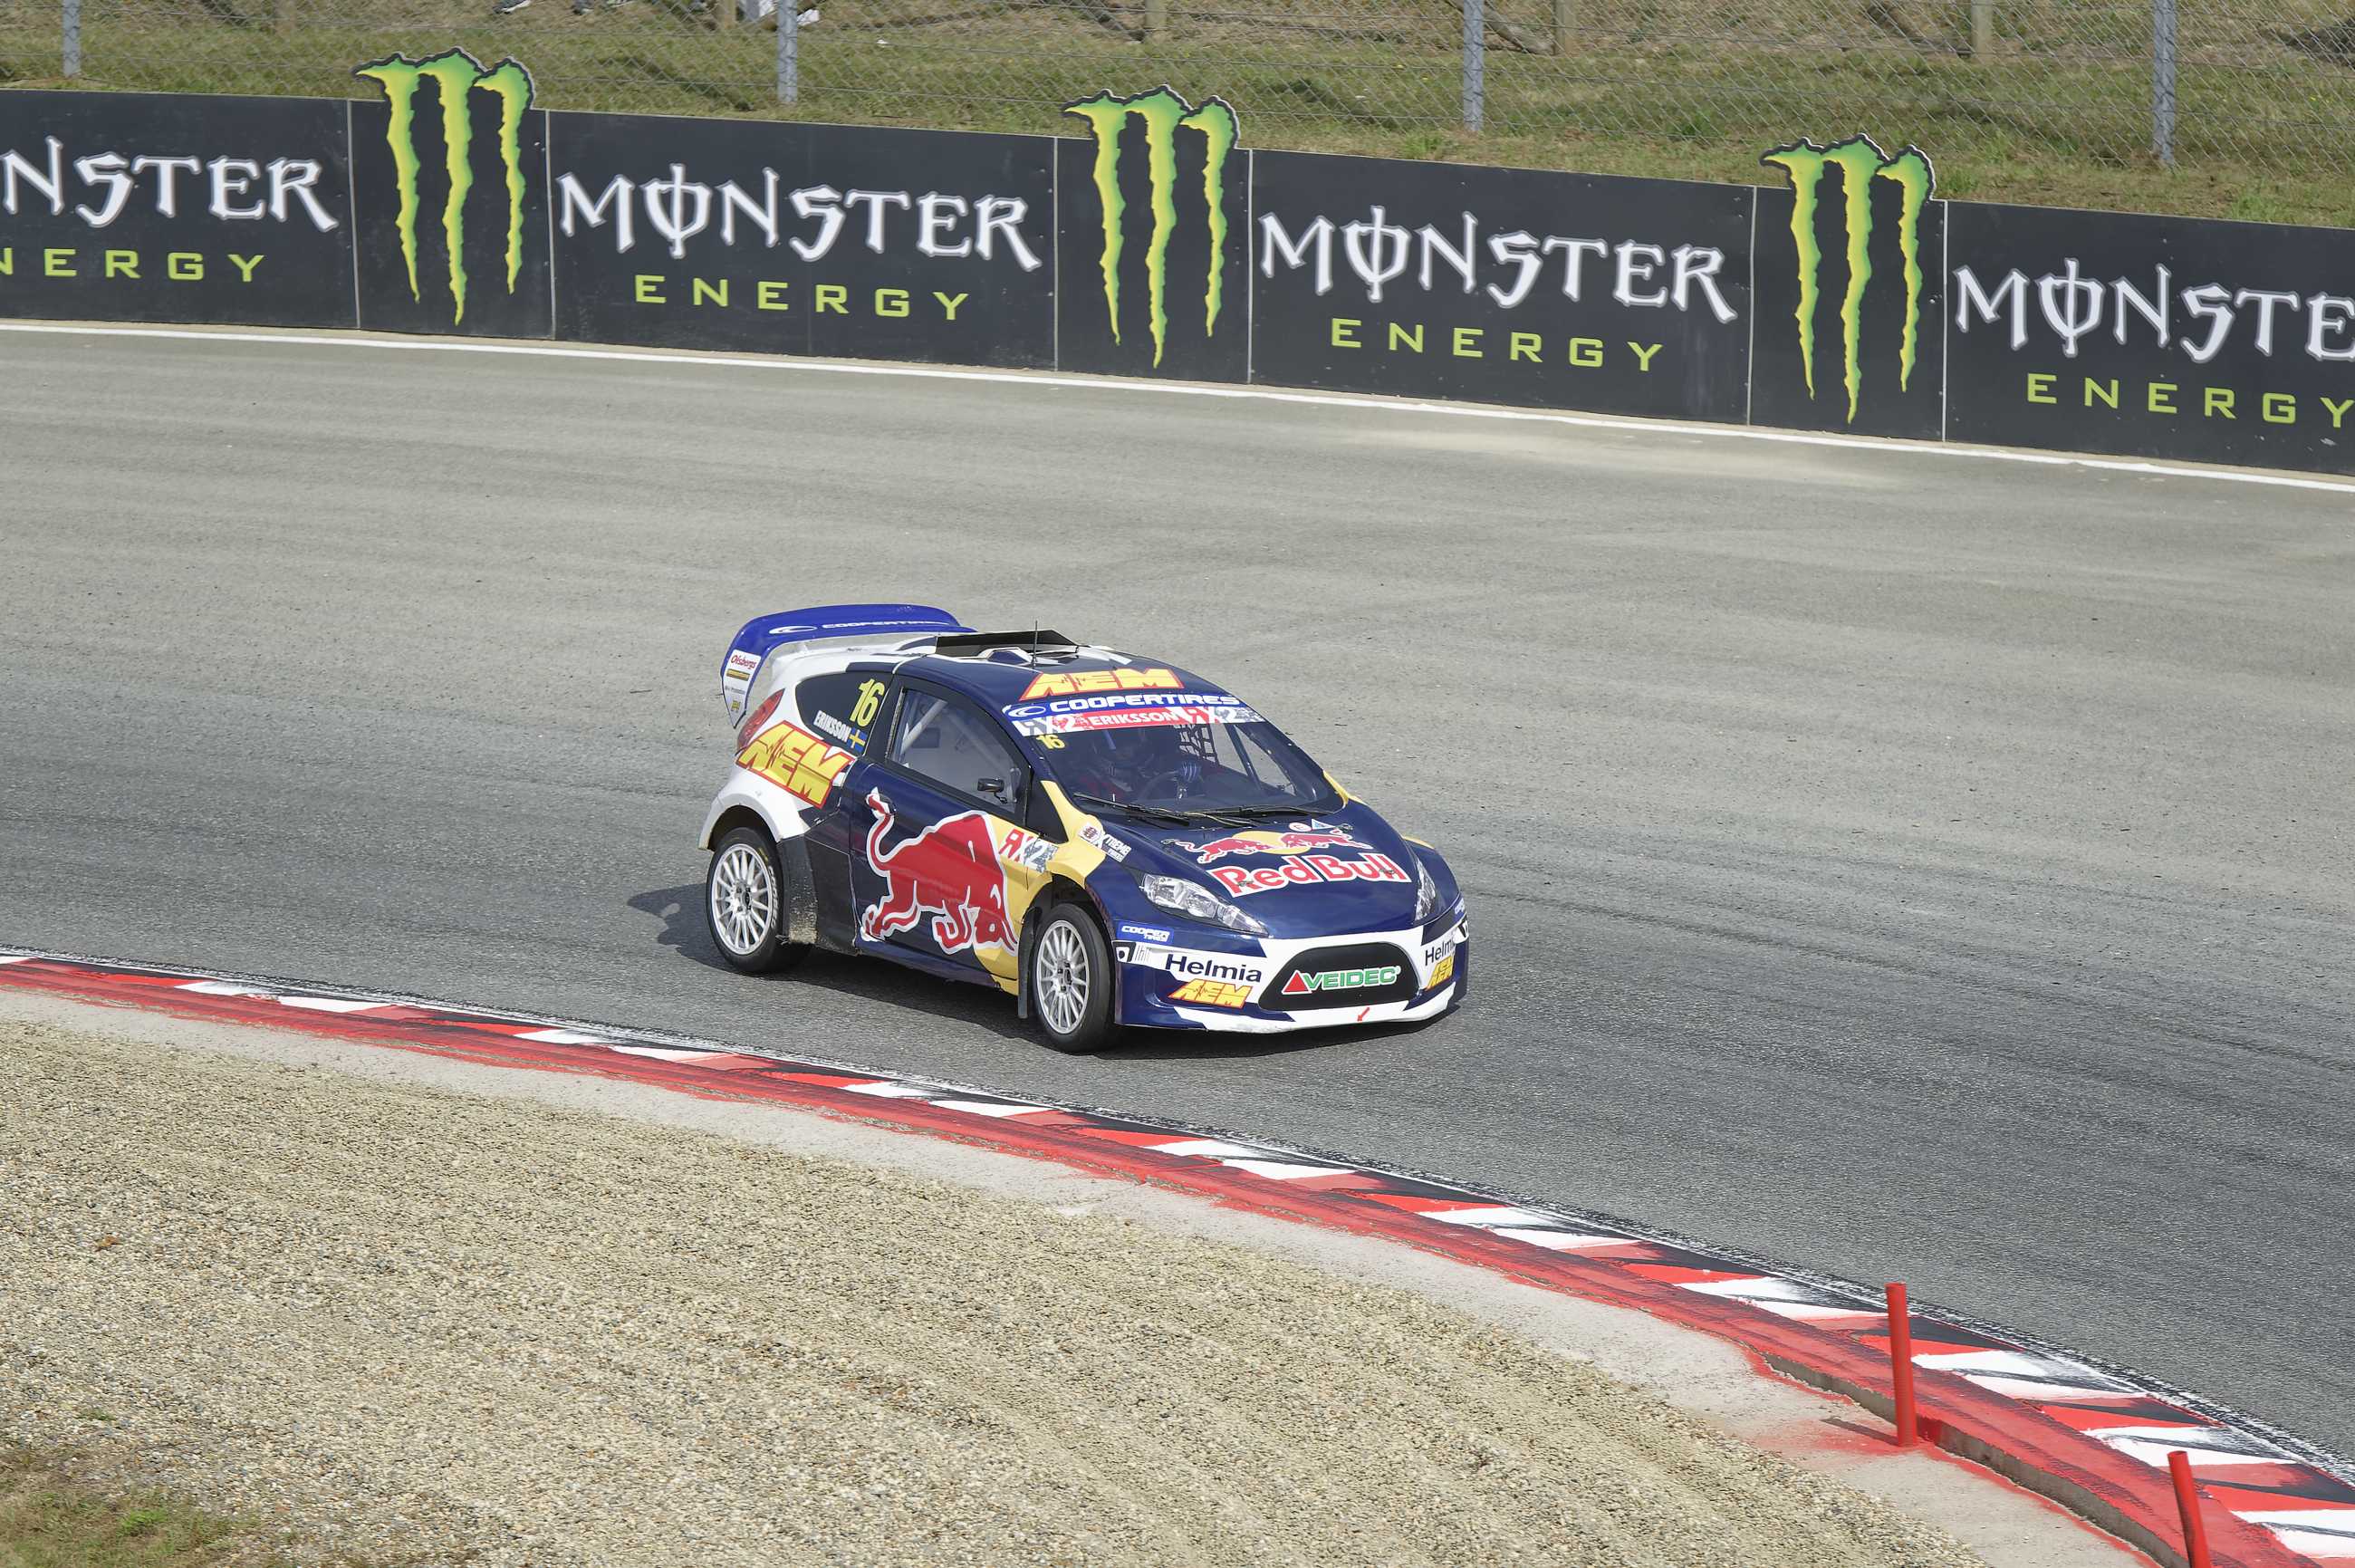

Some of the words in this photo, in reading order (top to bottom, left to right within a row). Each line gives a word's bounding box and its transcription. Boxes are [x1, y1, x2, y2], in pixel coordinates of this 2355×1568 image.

[0, 136, 339, 234] NSTER
[555, 162, 1043, 272] MONSTER
[0, 246, 264, 283] ERGY
[1258, 205, 1738, 324] MONSTER
[634, 274, 969, 321] ENERGY
[1954, 256, 2355, 363] MONSTE
[1331, 317, 1663, 372] ENERGY
[2026, 372, 2355, 428] ENERGY
[849, 678, 886, 727] 16
[1088, 711, 1177, 726] ERIKSSON
[813, 709, 853, 743] ERIKSSON
[1036, 735, 1066, 750] 16
[1206, 854, 1324, 898] Red
[1302, 852, 1413, 883] Bull
[1121, 925, 1171, 938] COOPER
[1165, 953, 1263, 983] Helmia
[1302, 966, 1398, 991] VEIDEC
